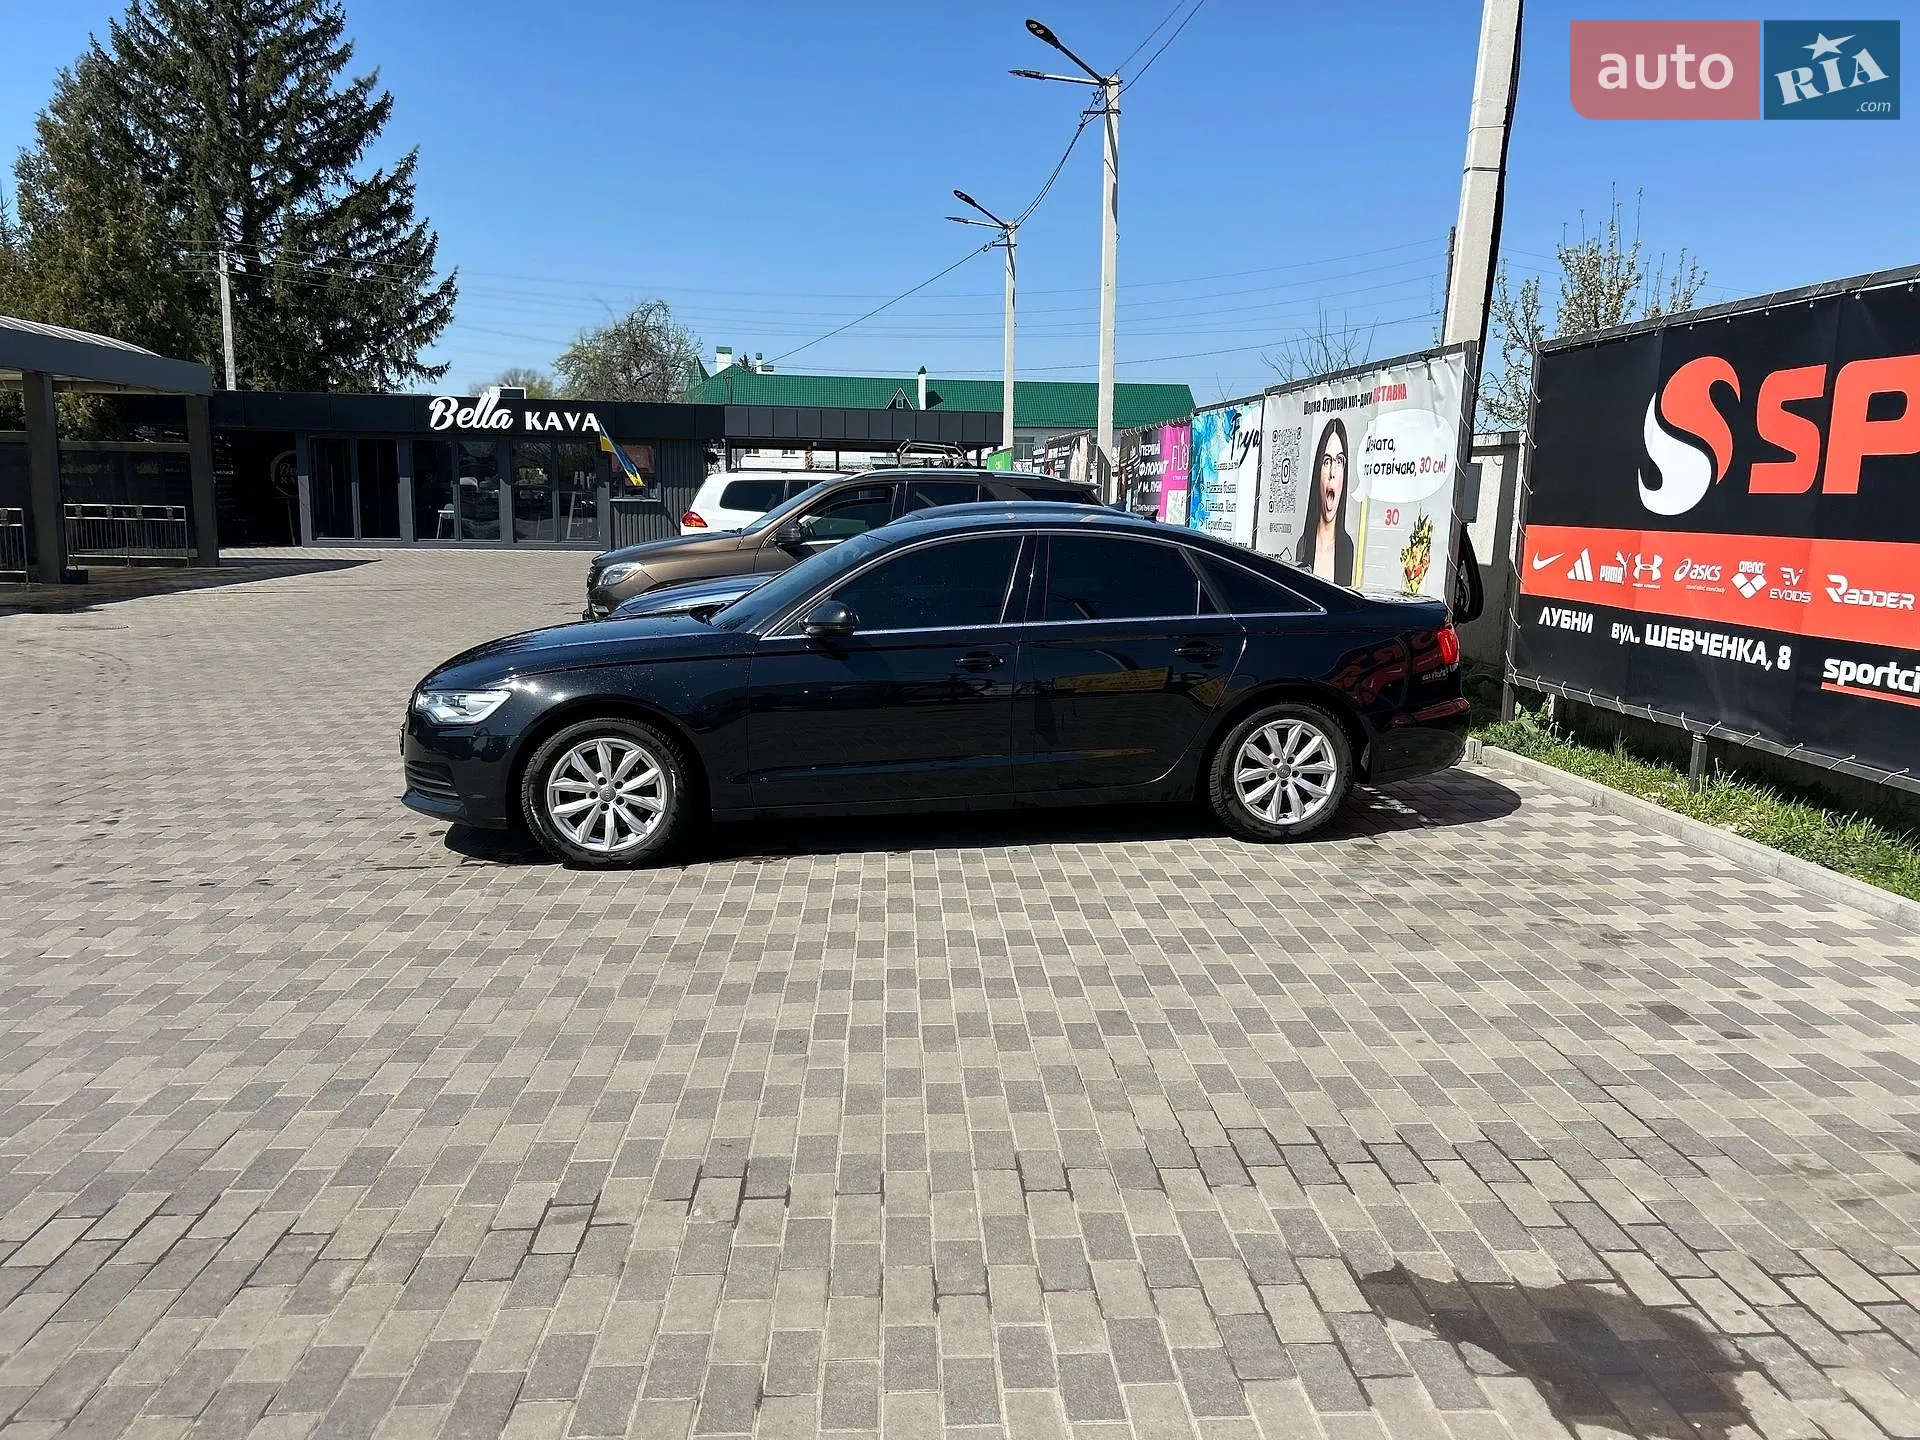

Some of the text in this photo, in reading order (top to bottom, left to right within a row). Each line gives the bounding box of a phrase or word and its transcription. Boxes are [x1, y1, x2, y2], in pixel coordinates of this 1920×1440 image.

[428, 391, 601, 432] Bella KAVA
[1419, 456, 1431, 474] 30
[1433, 453, 1447, 474] см!
[1384, 508, 1400, 526] 30
[1538, 606, 1792, 672] ЛУБНИ вул. ШЕВЧЕНКА, 8
